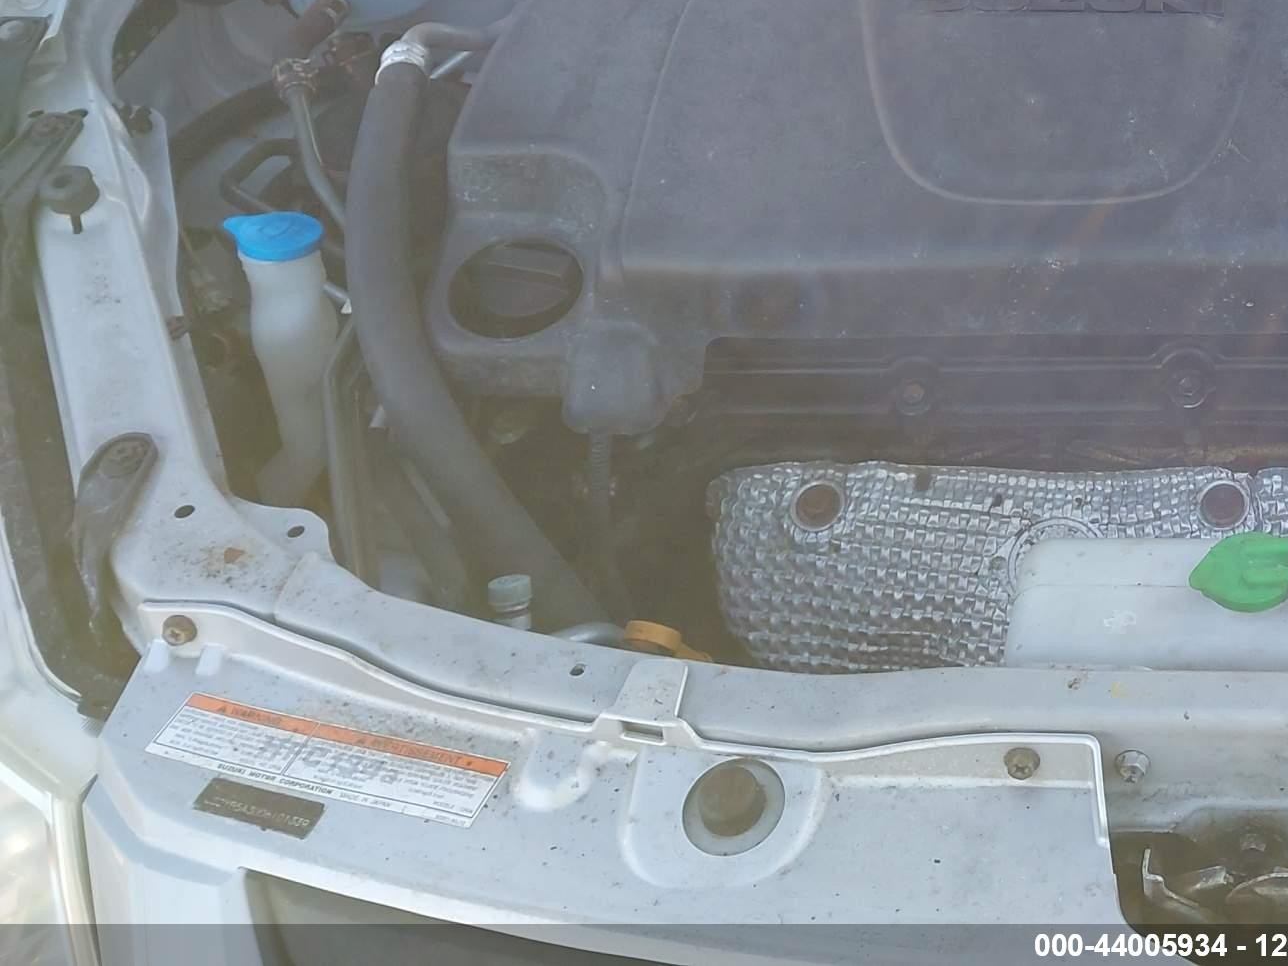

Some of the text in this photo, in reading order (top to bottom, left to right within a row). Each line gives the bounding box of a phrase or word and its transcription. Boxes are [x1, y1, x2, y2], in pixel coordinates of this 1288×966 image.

[217, 763, 246, 774] SUZUKI
[249, 771, 275, 782] MOTOR
[279, 777, 333, 795] CORPORATION
